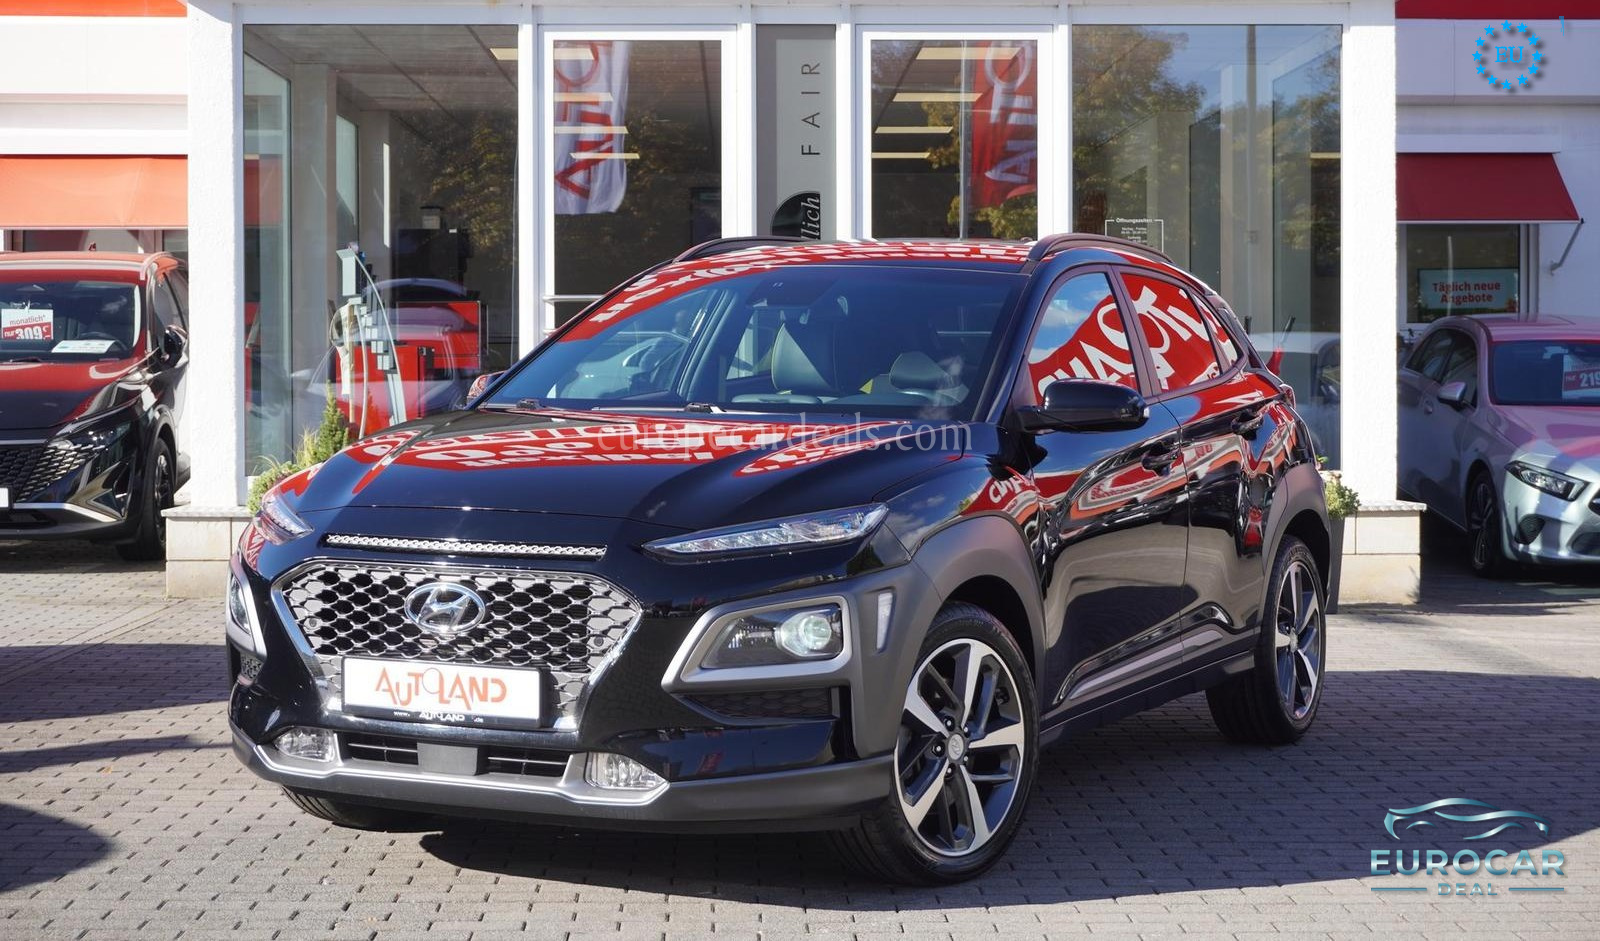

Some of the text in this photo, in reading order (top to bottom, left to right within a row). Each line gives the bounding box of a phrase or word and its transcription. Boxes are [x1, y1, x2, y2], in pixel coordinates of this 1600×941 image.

[801, 62, 821, 156] FAIR
[1432, 281, 1501, 293] Täglich neue
[1440, 293, 1493, 305] Angebote
